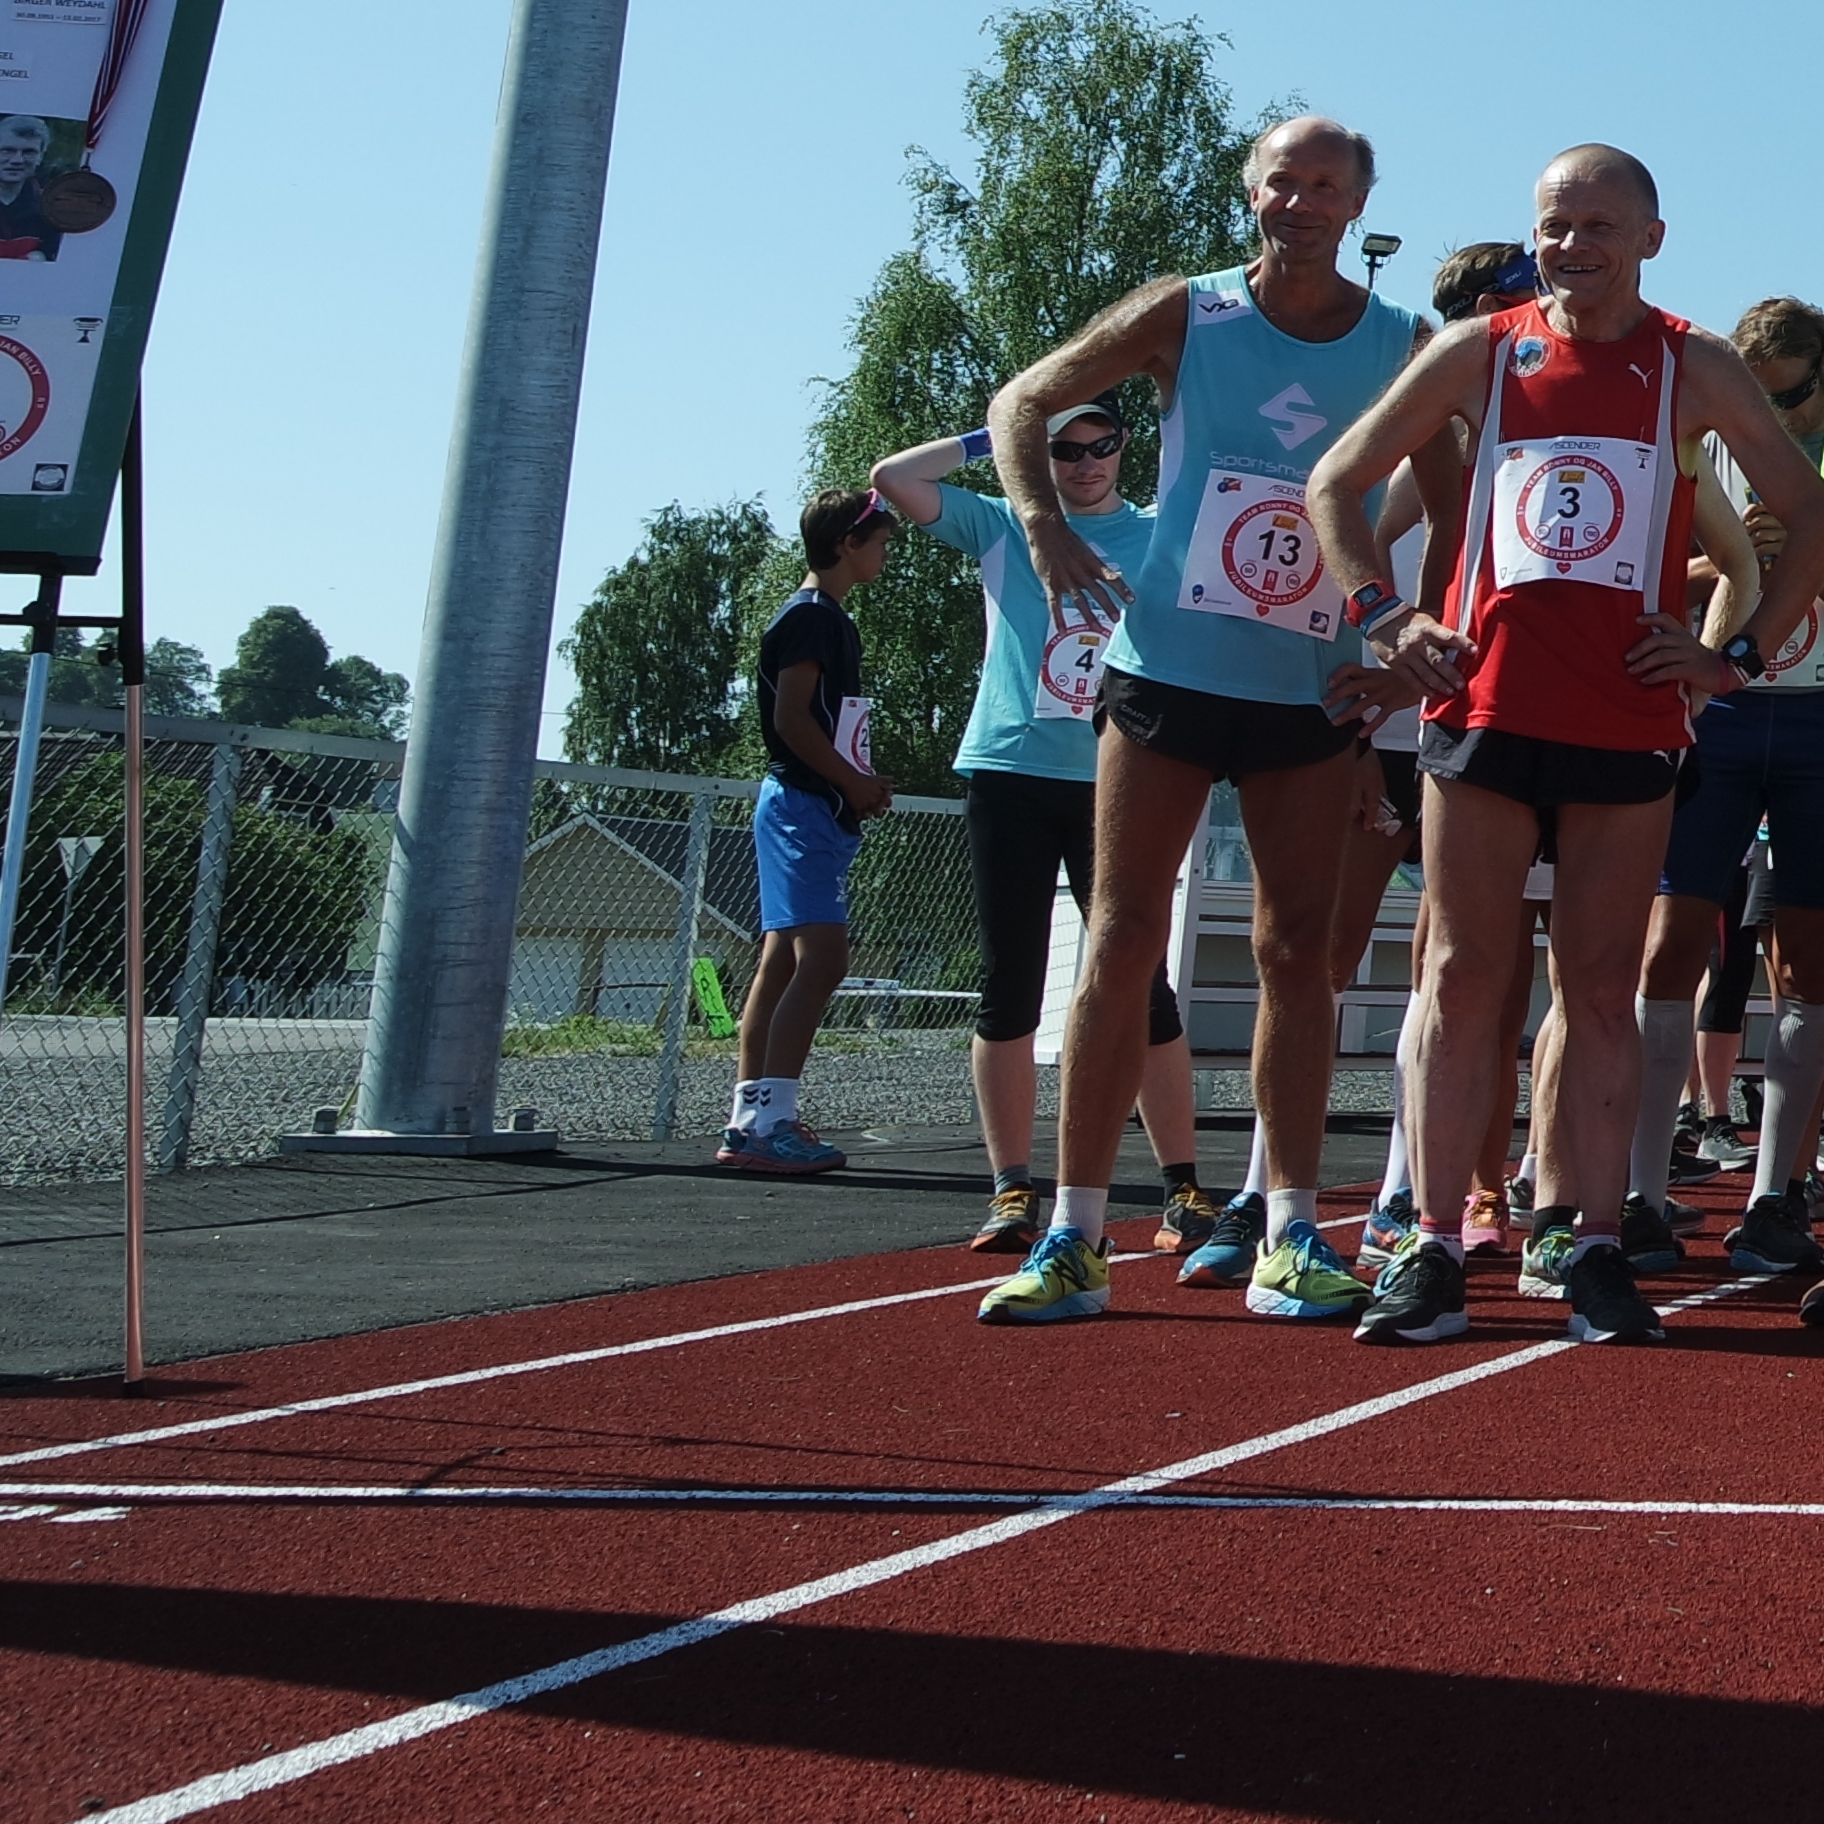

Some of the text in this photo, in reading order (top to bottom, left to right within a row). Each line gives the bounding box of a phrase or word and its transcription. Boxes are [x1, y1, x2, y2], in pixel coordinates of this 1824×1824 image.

[19, 352, 41, 376] BILLY
[1549, 441, 1601, 450] ASCENDER
[1526, 469, 1543, 488] TEAM
[1544, 458, 1571, 471] RONNY
[1587, 461, 1602, 473] JAN
[1602, 470, 1619, 491] BILLY
[1238, 507, 1258, 523] TEAM
[1260, 502, 1288, 510] RONNY
[1289, 505, 1300, 513] OG
[1557, 487, 1580, 518] 3
[1258, 530, 1301, 566] 13
[1525, 536, 1610, 559] JUBILEUMSMARATON
[1229, 570, 1308, 604] JUBILEUMSMARATON
[1075, 649, 1094, 672] 4
